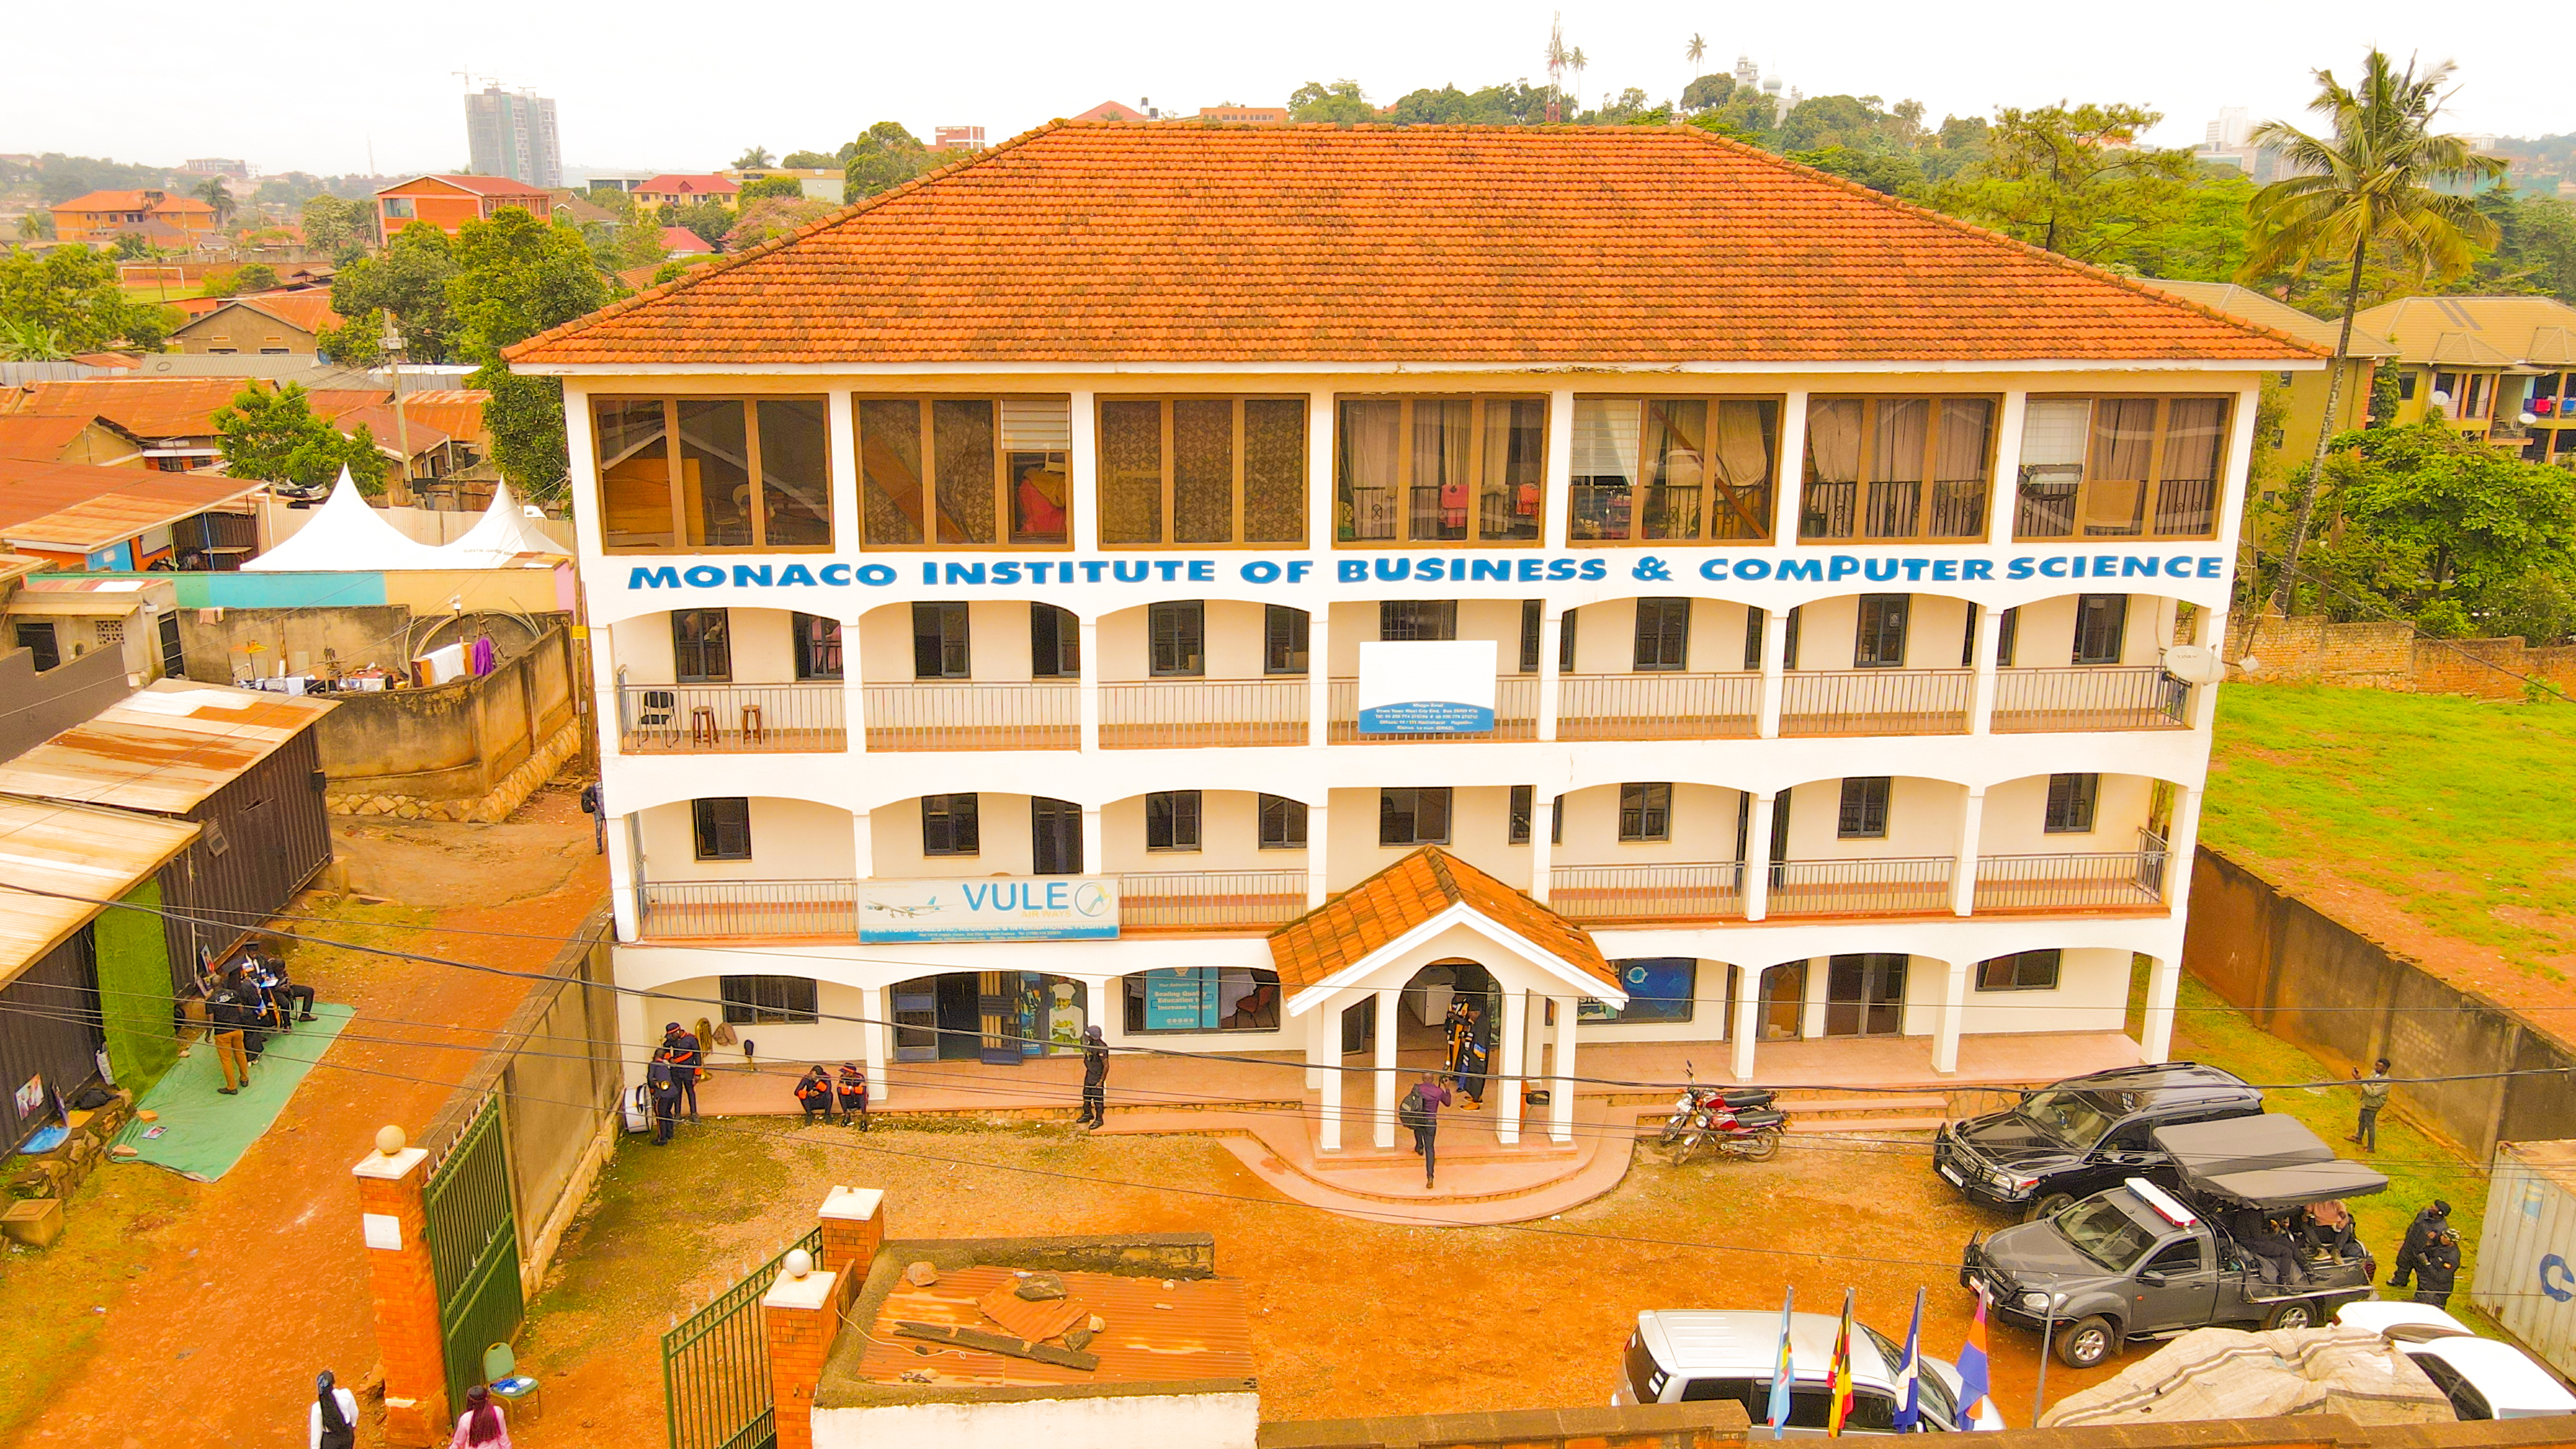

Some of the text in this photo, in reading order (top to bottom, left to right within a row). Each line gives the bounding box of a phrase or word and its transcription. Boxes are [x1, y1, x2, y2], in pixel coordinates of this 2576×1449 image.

[629, 556, 2222, 589] MONACO INSTITUTE OF BUSINESS & COMPUTER SCIENCE
[962, 882, 1068, 911] VULE
[1021, 909, 1072, 918] AIR WAYS
